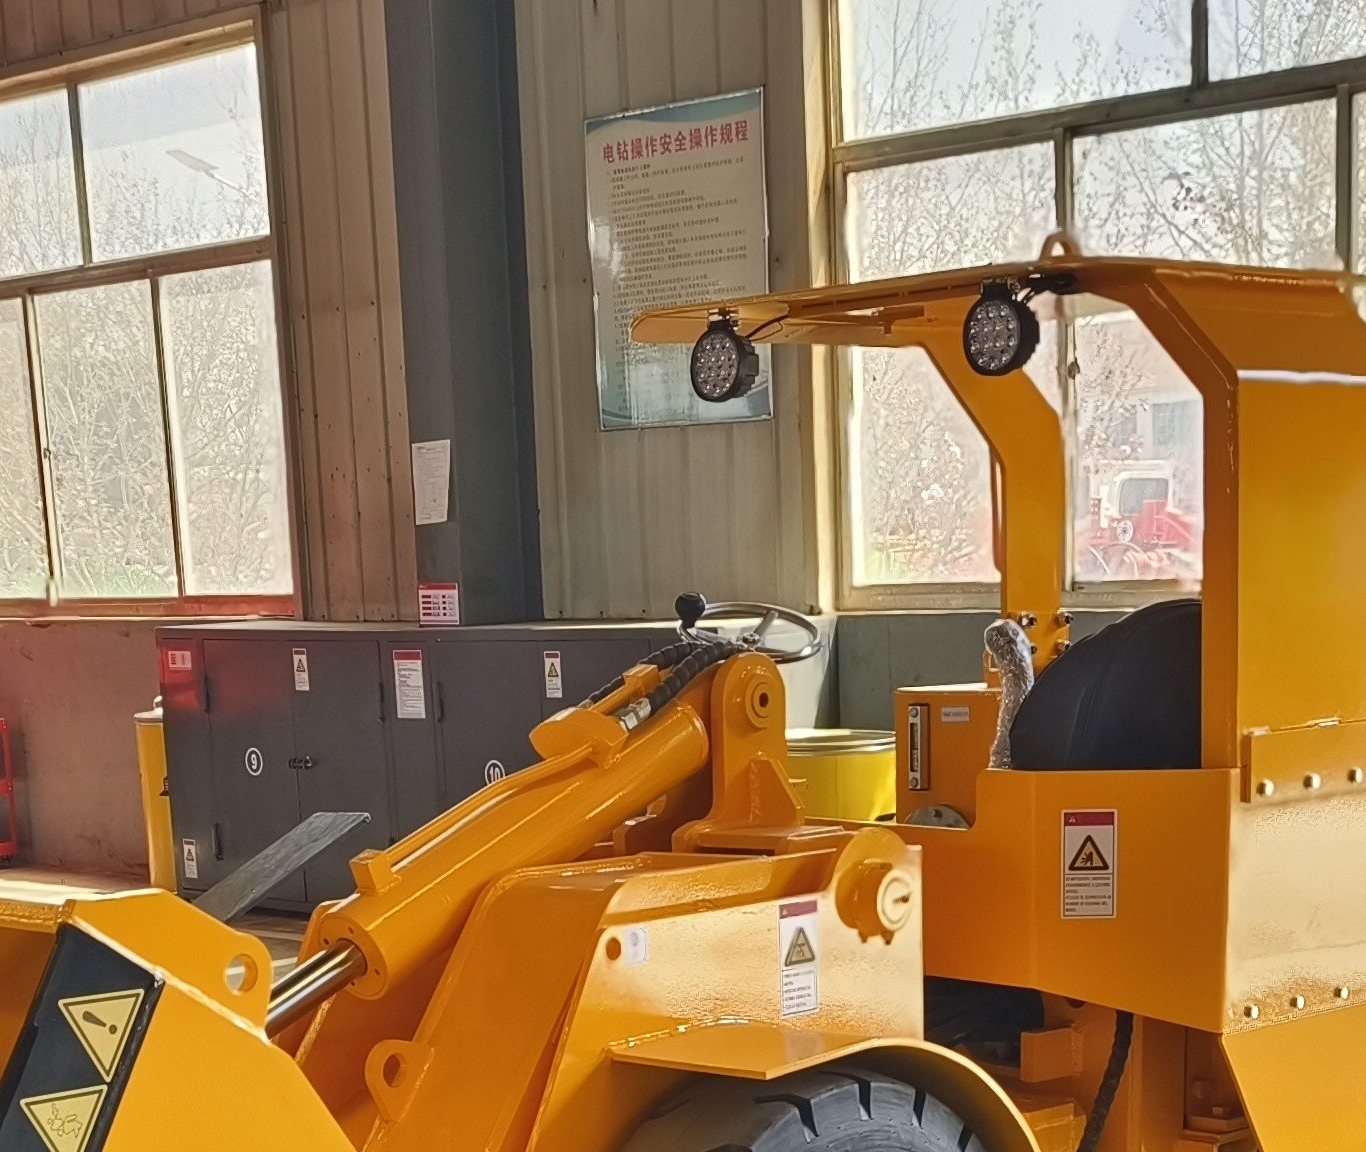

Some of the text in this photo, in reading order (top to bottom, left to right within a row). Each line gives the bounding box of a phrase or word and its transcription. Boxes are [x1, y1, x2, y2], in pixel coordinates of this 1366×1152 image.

[602, 119, 749, 164] 电钻操作安全操作规程
